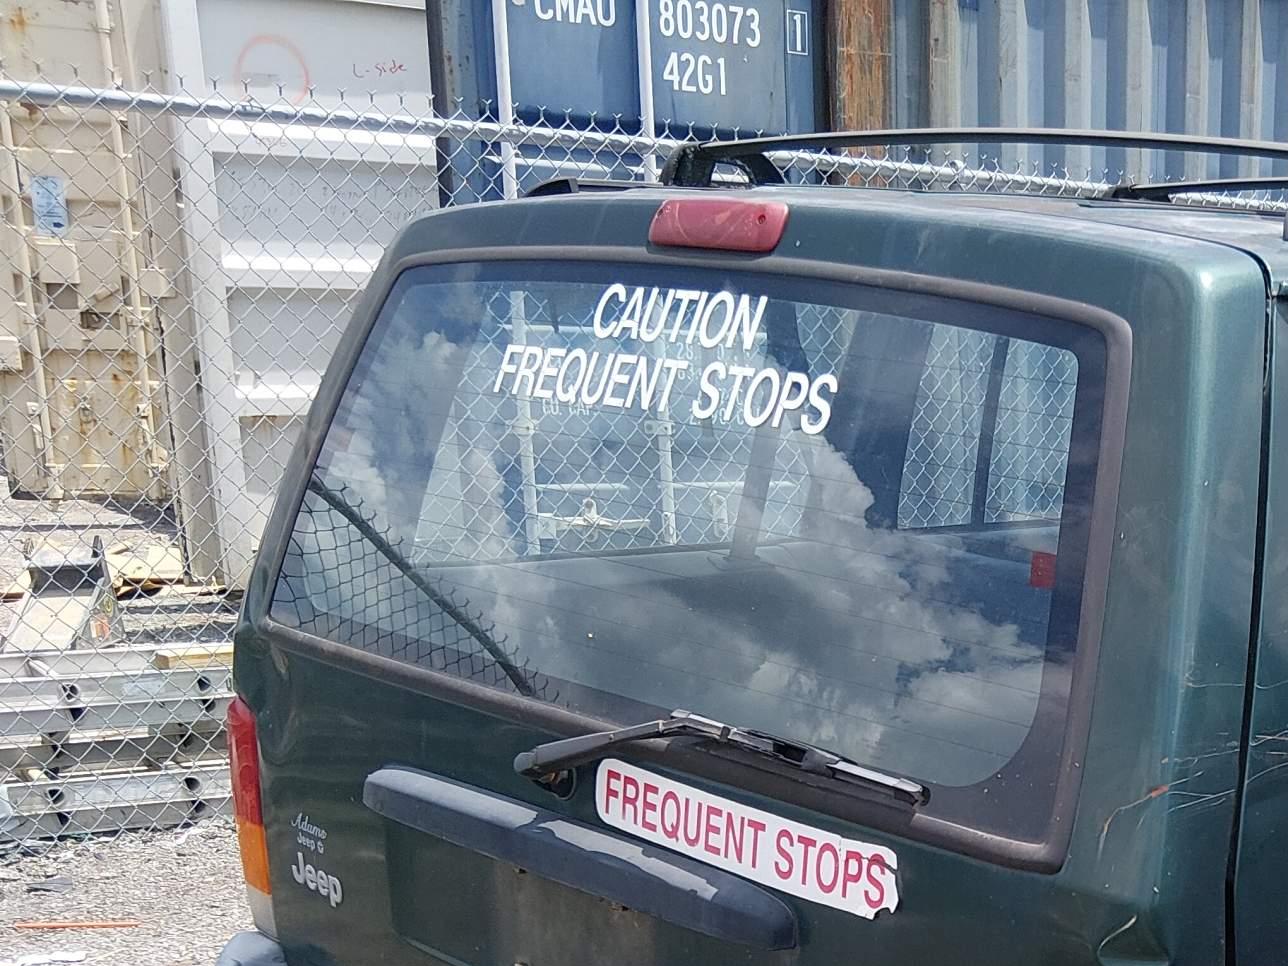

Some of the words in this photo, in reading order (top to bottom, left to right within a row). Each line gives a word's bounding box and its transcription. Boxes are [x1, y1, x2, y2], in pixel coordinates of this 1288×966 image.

[659, 0, 761, 47] 803073
[793, 14, 803, 51] 1
[663, 52, 727, 95] 42G1
[593, 283, 768, 350] CAUTION
[493, 344, 688, 413] FREQUENT
[692, 361, 838, 435] STOPS
[291, 812, 327, 839] Adams
[604, 769, 766, 870] FREQUENT
[774, 829, 887, 909] STOPS
[291, 851, 343, 908] Jeep
